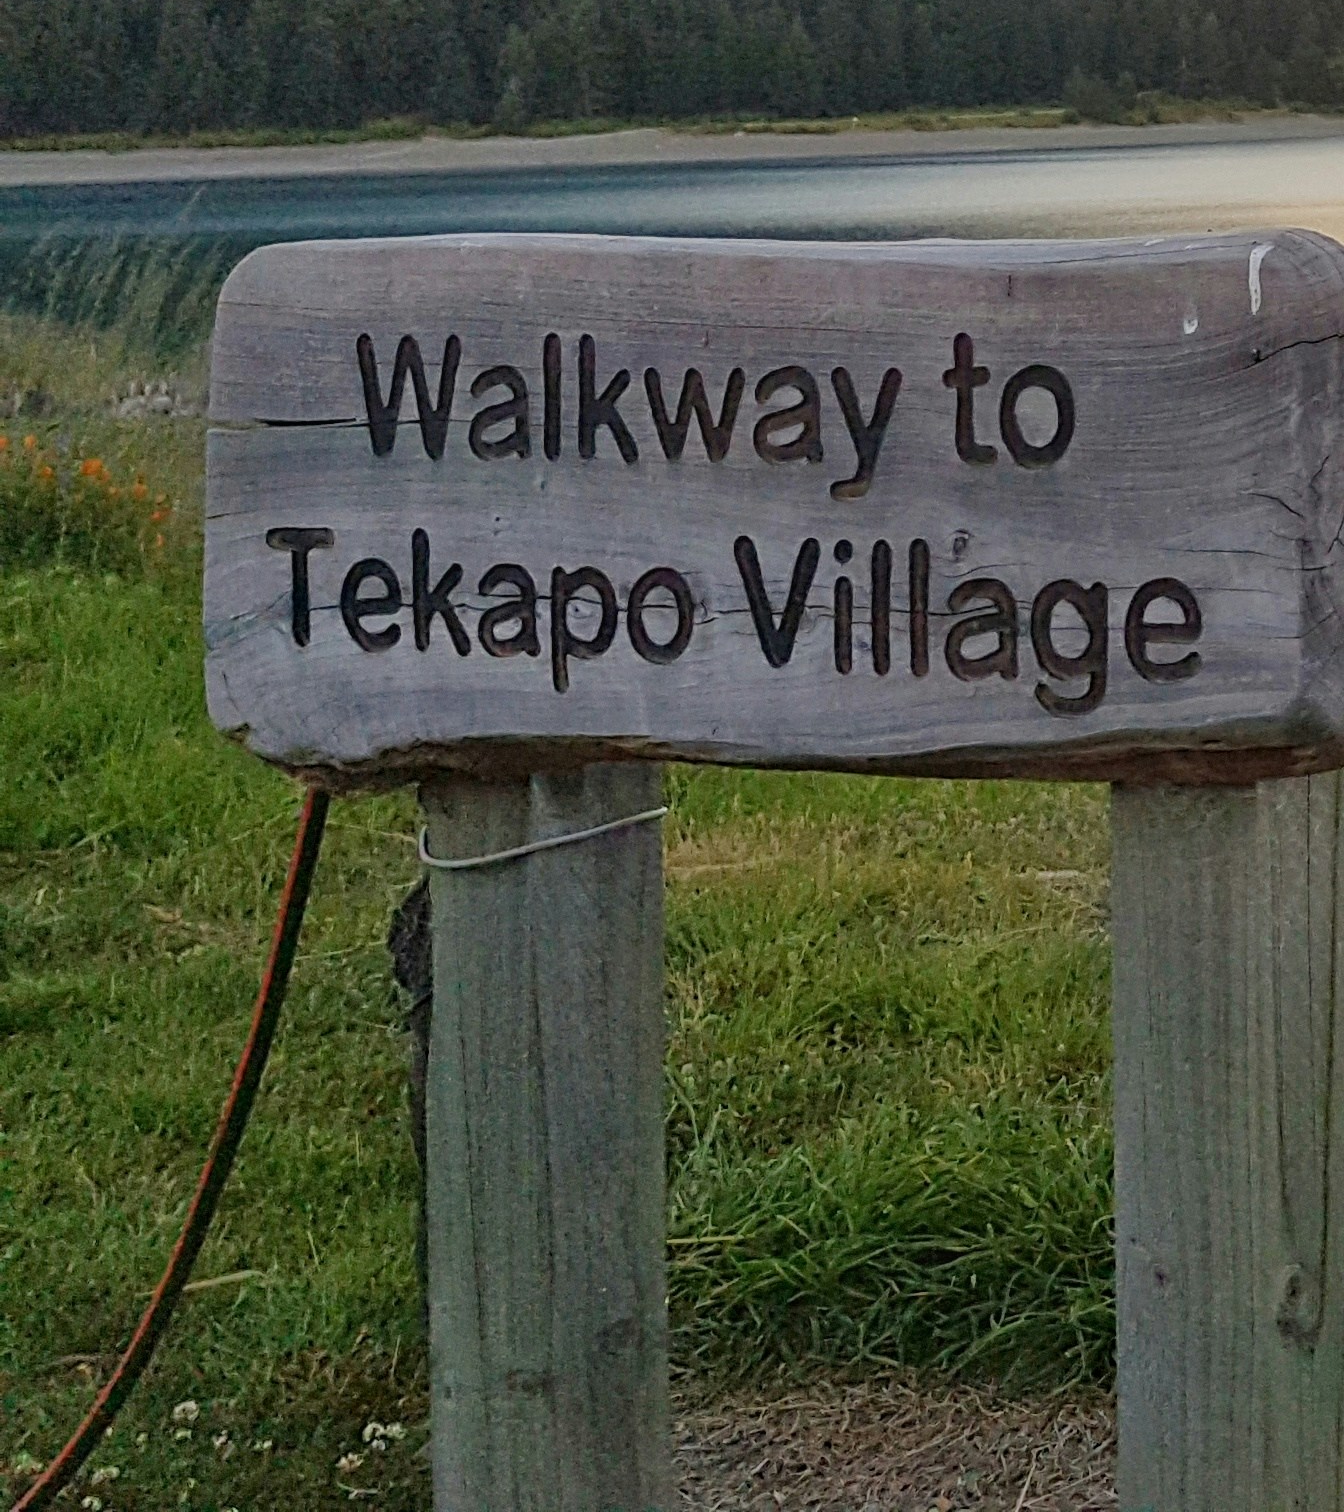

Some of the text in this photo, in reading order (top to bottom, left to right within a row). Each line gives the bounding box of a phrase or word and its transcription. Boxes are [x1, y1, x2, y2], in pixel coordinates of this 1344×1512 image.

[355, 331, 1075, 499] Walkway to
[265, 525, 1202, 716] Tekapo Village
